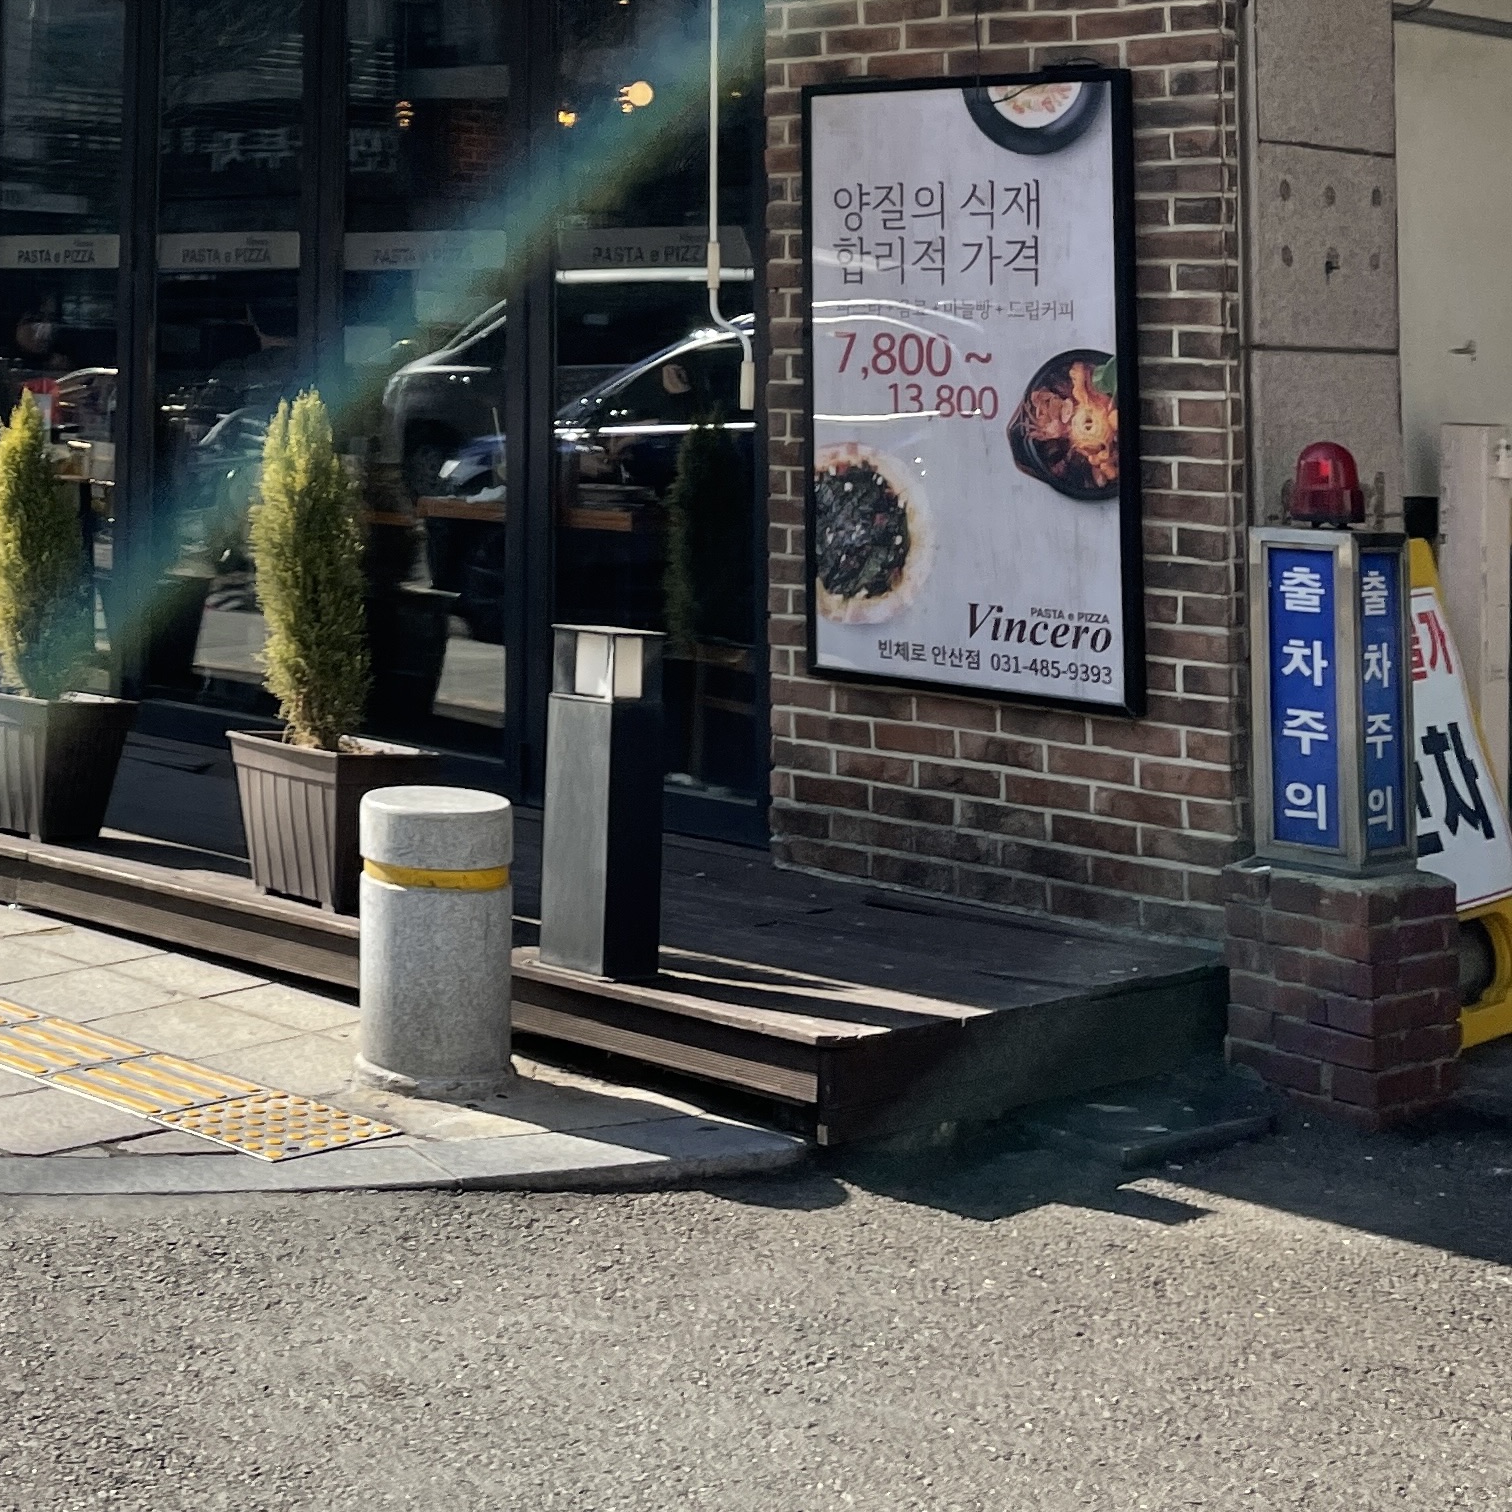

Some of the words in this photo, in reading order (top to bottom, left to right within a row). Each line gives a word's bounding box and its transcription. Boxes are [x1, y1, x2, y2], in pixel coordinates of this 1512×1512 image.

[833, 180, 946, 233] 양질의
[959, 178, 1041, 231] 식재
[17, 250, 53, 265] PASTA
[63, 249, 97, 264] PIZZA
[182, 248, 223, 265] PASTA
[235, 248, 272, 264] PIZZA
[592, 246, 645, 264] PASTA
[663, 244, 708, 263] PIZZ
[832, 235, 946, 287] 합리적
[959, 234, 1040, 288] 가격
[1007, 299, 1074, 322] 드립커피
[834, 331, 952, 381] 7,800
[887, 382, 999, 422] 13,800
[967, 601, 1113, 654] Vincero
[1030, 606, 1065, 621] PASTA
[1076, 611, 1111, 625] PIZZA
[877, 638, 928, 663] 빈체로
[931, 644, 981, 671] 안산점
[990, 652, 1113, 686] 031-485-9393
[1279, 566, 1330, 831] 출차주의
[1361, 570, 1394, 833] 출차주의
